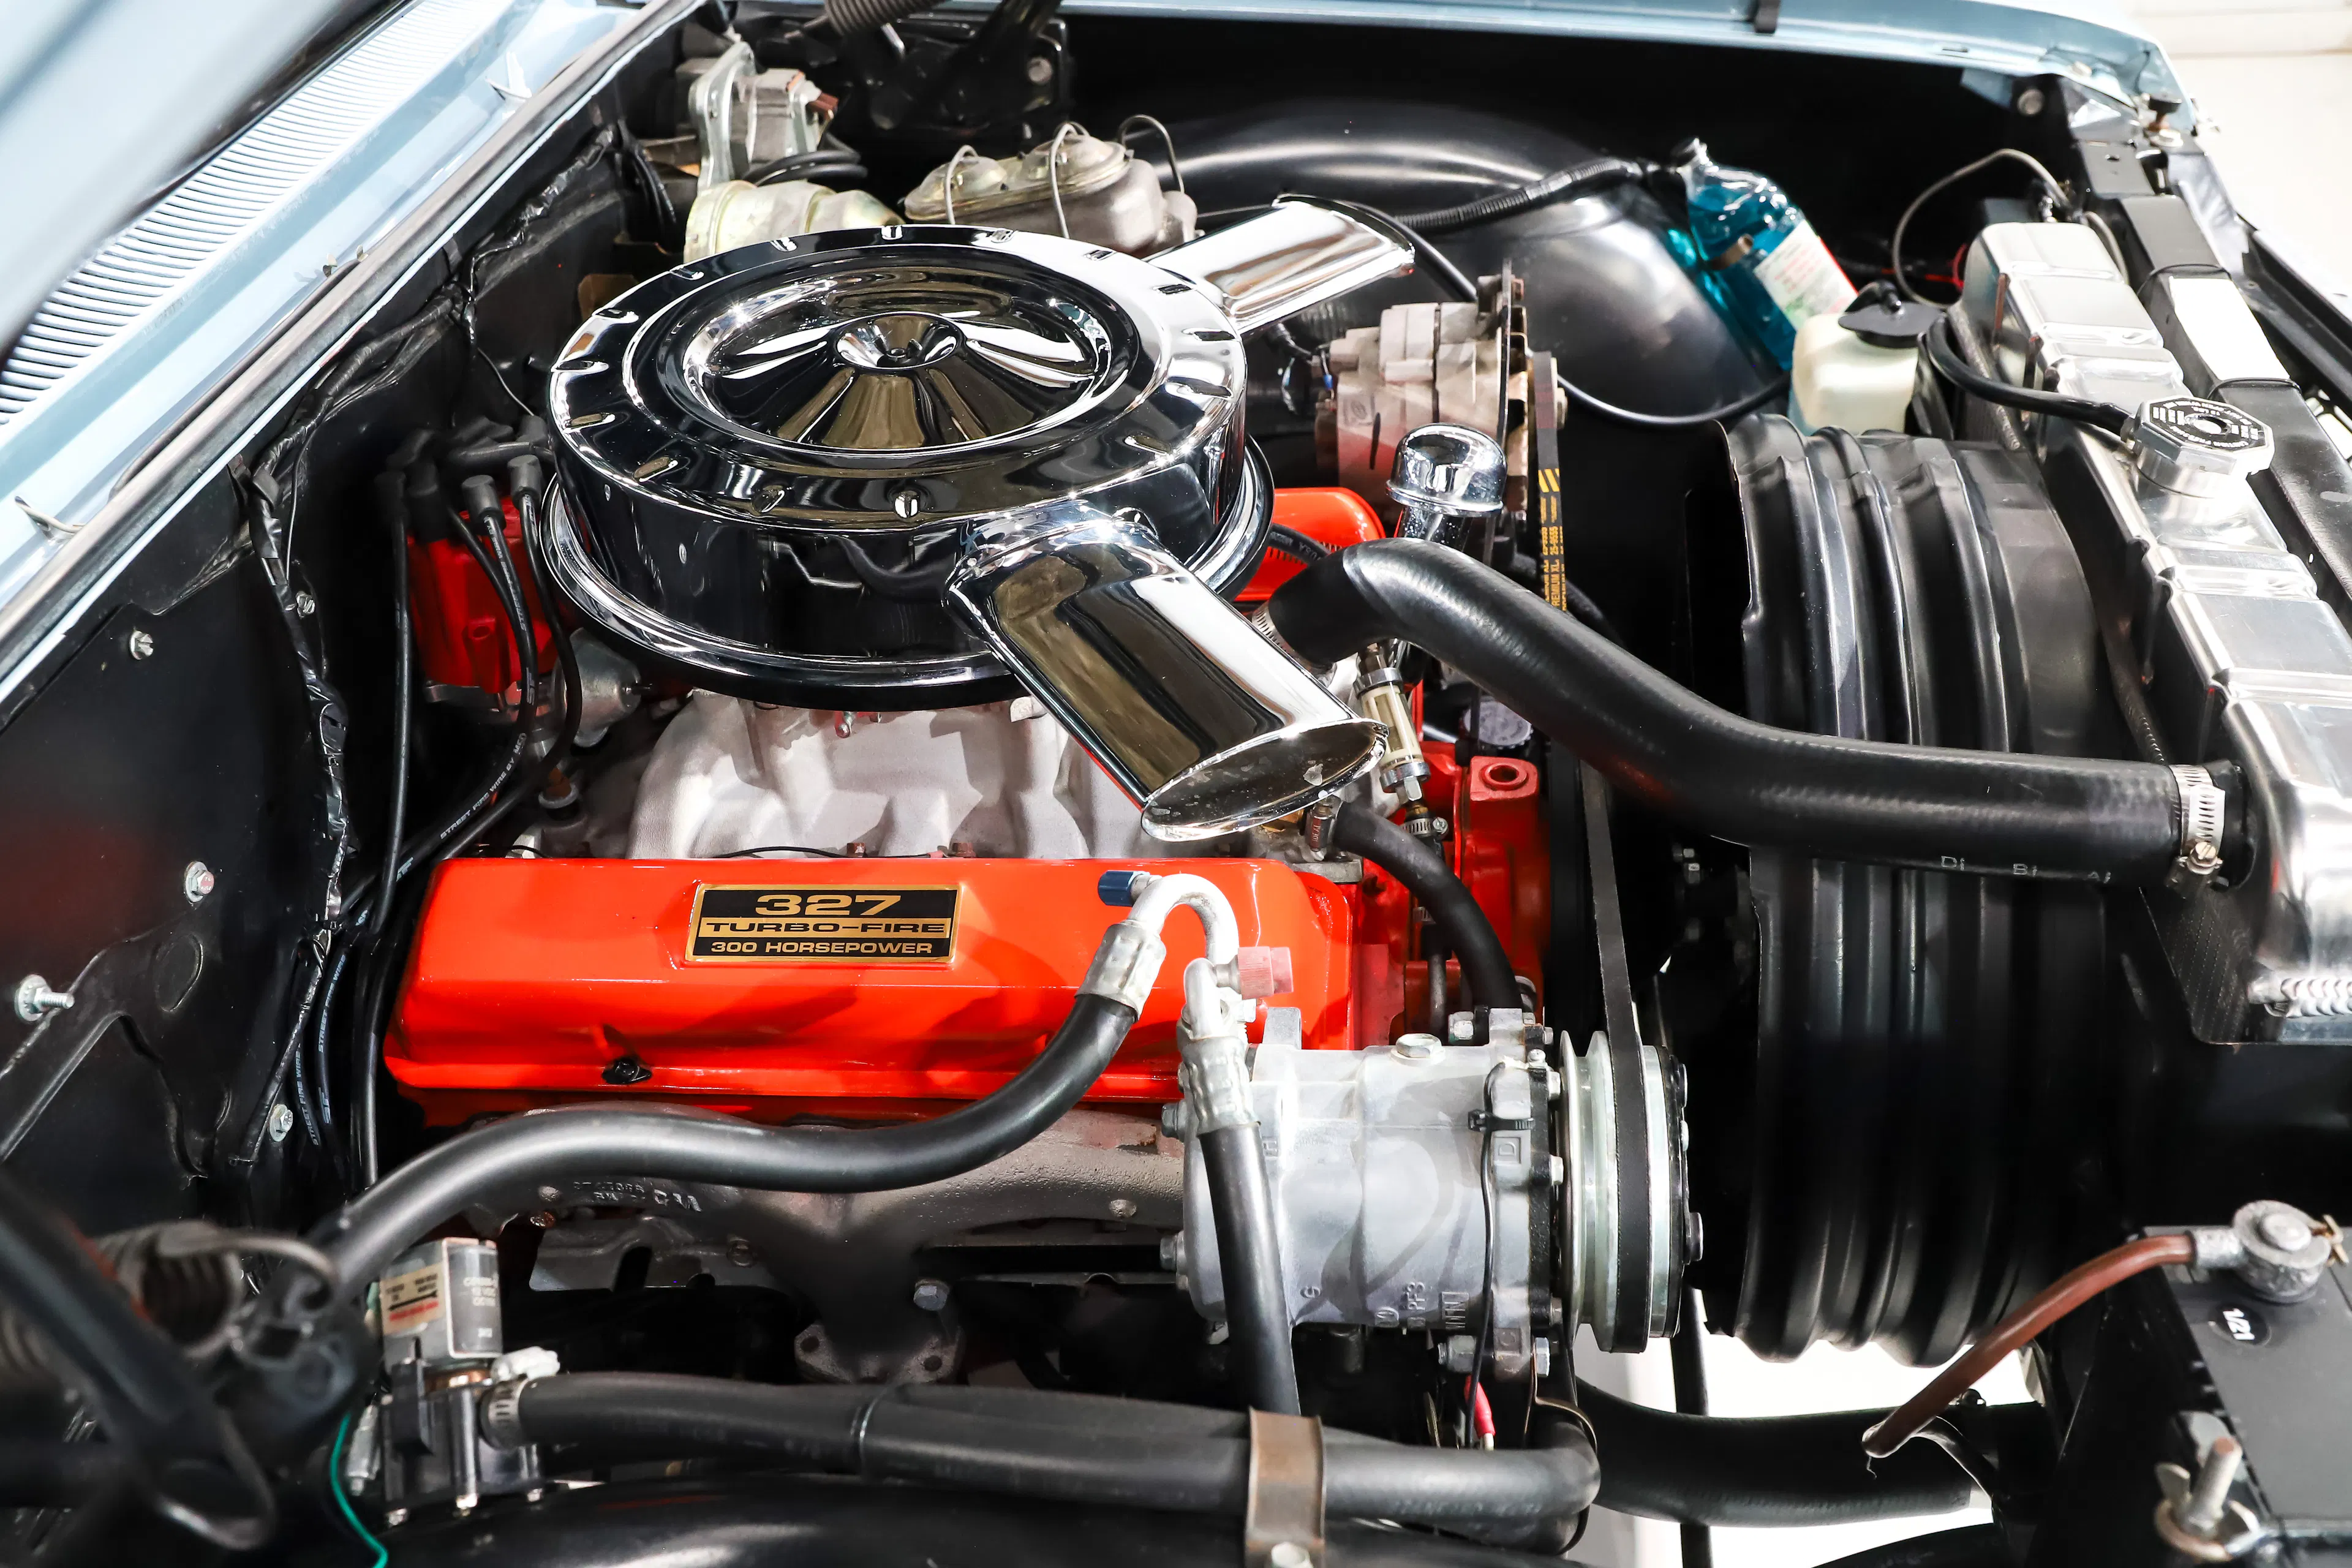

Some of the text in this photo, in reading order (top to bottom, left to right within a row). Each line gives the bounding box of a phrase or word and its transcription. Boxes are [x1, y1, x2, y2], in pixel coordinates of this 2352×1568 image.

[1550, 573, 1561, 608] REMIUM
[440, 809, 471, 840] STREET
[472, 792, 490, 810] FIRE
[489, 771, 507, 793] WIRE
[506, 757, 515, 771] BY
[755, 894, 901, 916] 327
[706, 922, 946, 933] TURBO-FIRE
[710, 941, 933, 954] 300 HORSEPOWER
[318, 1009, 328, 1054] STREET
[325, 982, 335, 1008] FIRE
[333, 953, 347, 981] WIRE
[296, 1080, 306, 1105] FIRE
[301, 1106, 319, 1146] STREET
[2222, 1308, 2256, 1341] 1/21
